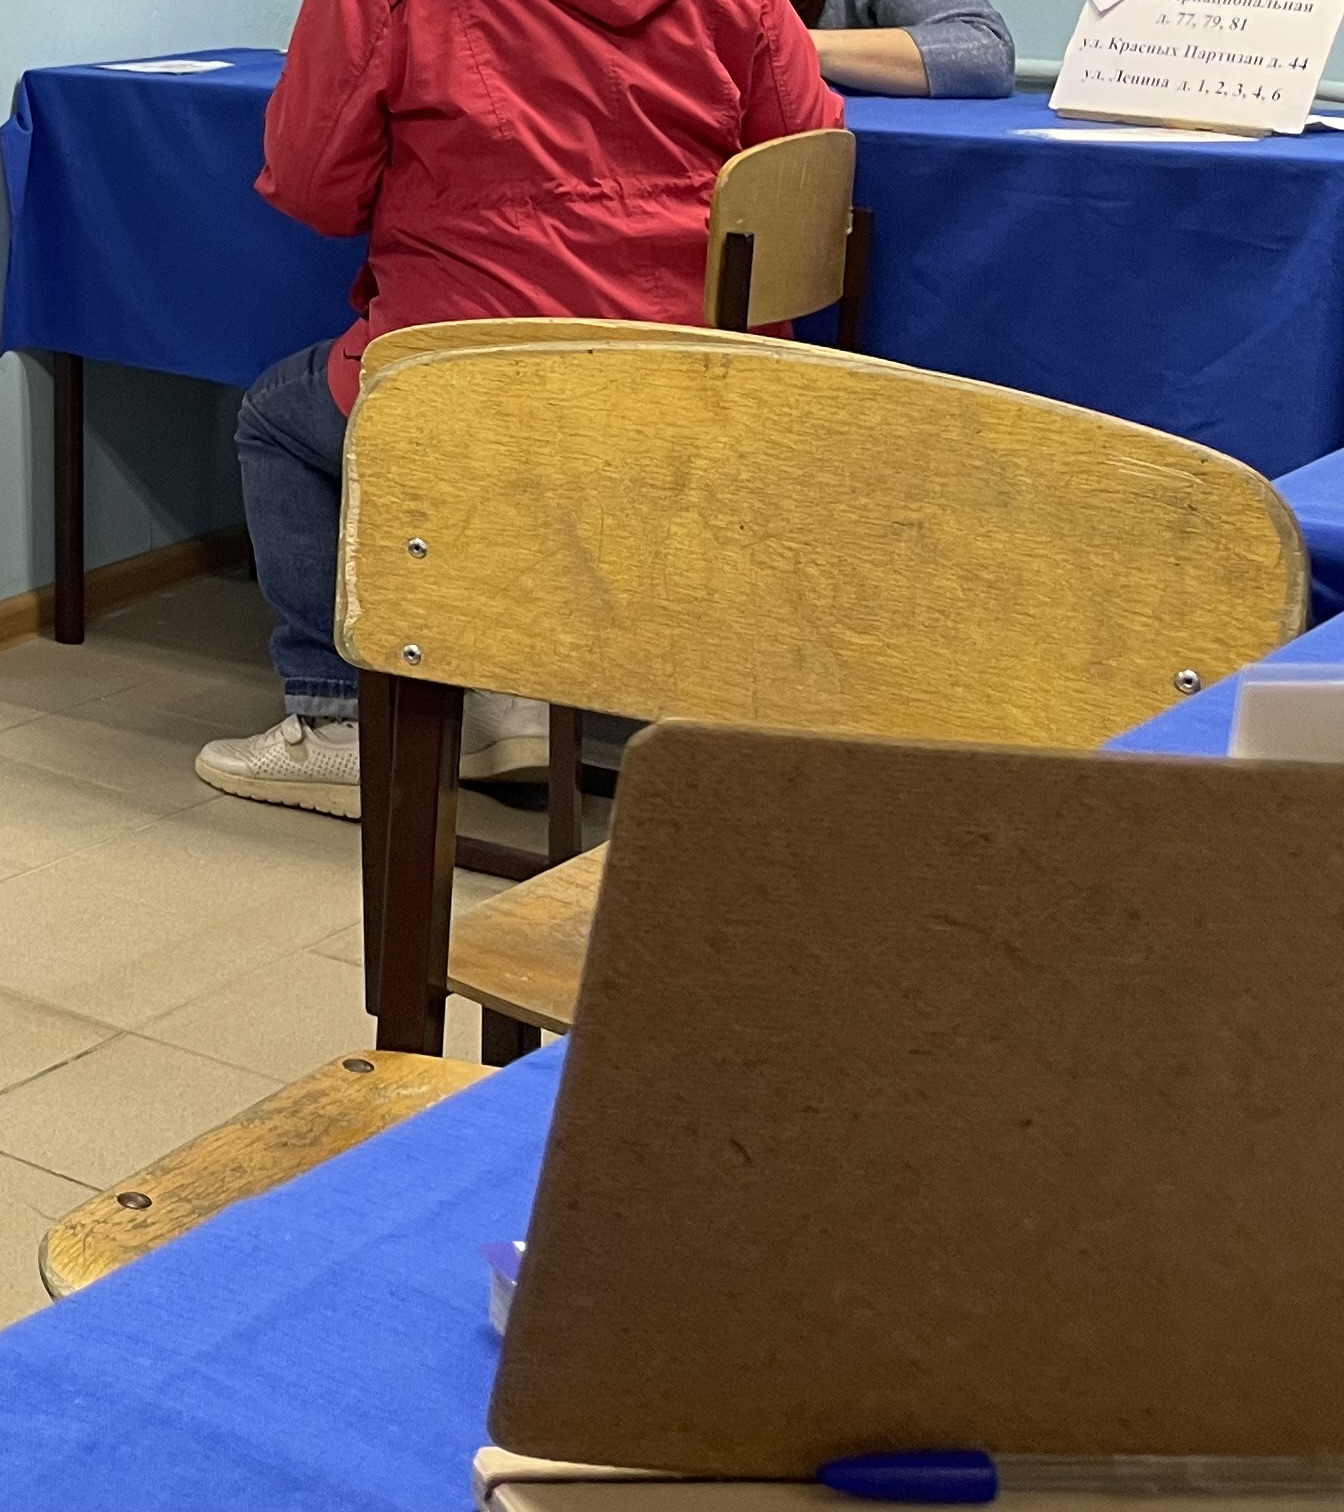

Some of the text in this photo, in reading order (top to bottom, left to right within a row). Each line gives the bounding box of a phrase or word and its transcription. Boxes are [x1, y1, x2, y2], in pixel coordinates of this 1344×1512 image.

[1176, 12, 1197, 28] 77,
[1229, 17, 1247, 31] 81
[1079, 37, 1309, 72] ул. Красных Партизан д. 44
[1081, 69, 1105, 83] ул.
[1108, 69, 1170, 89] Ленина
[1176, 80, 1191, 92] д.
[1271, 87, 1282, 102] 6
